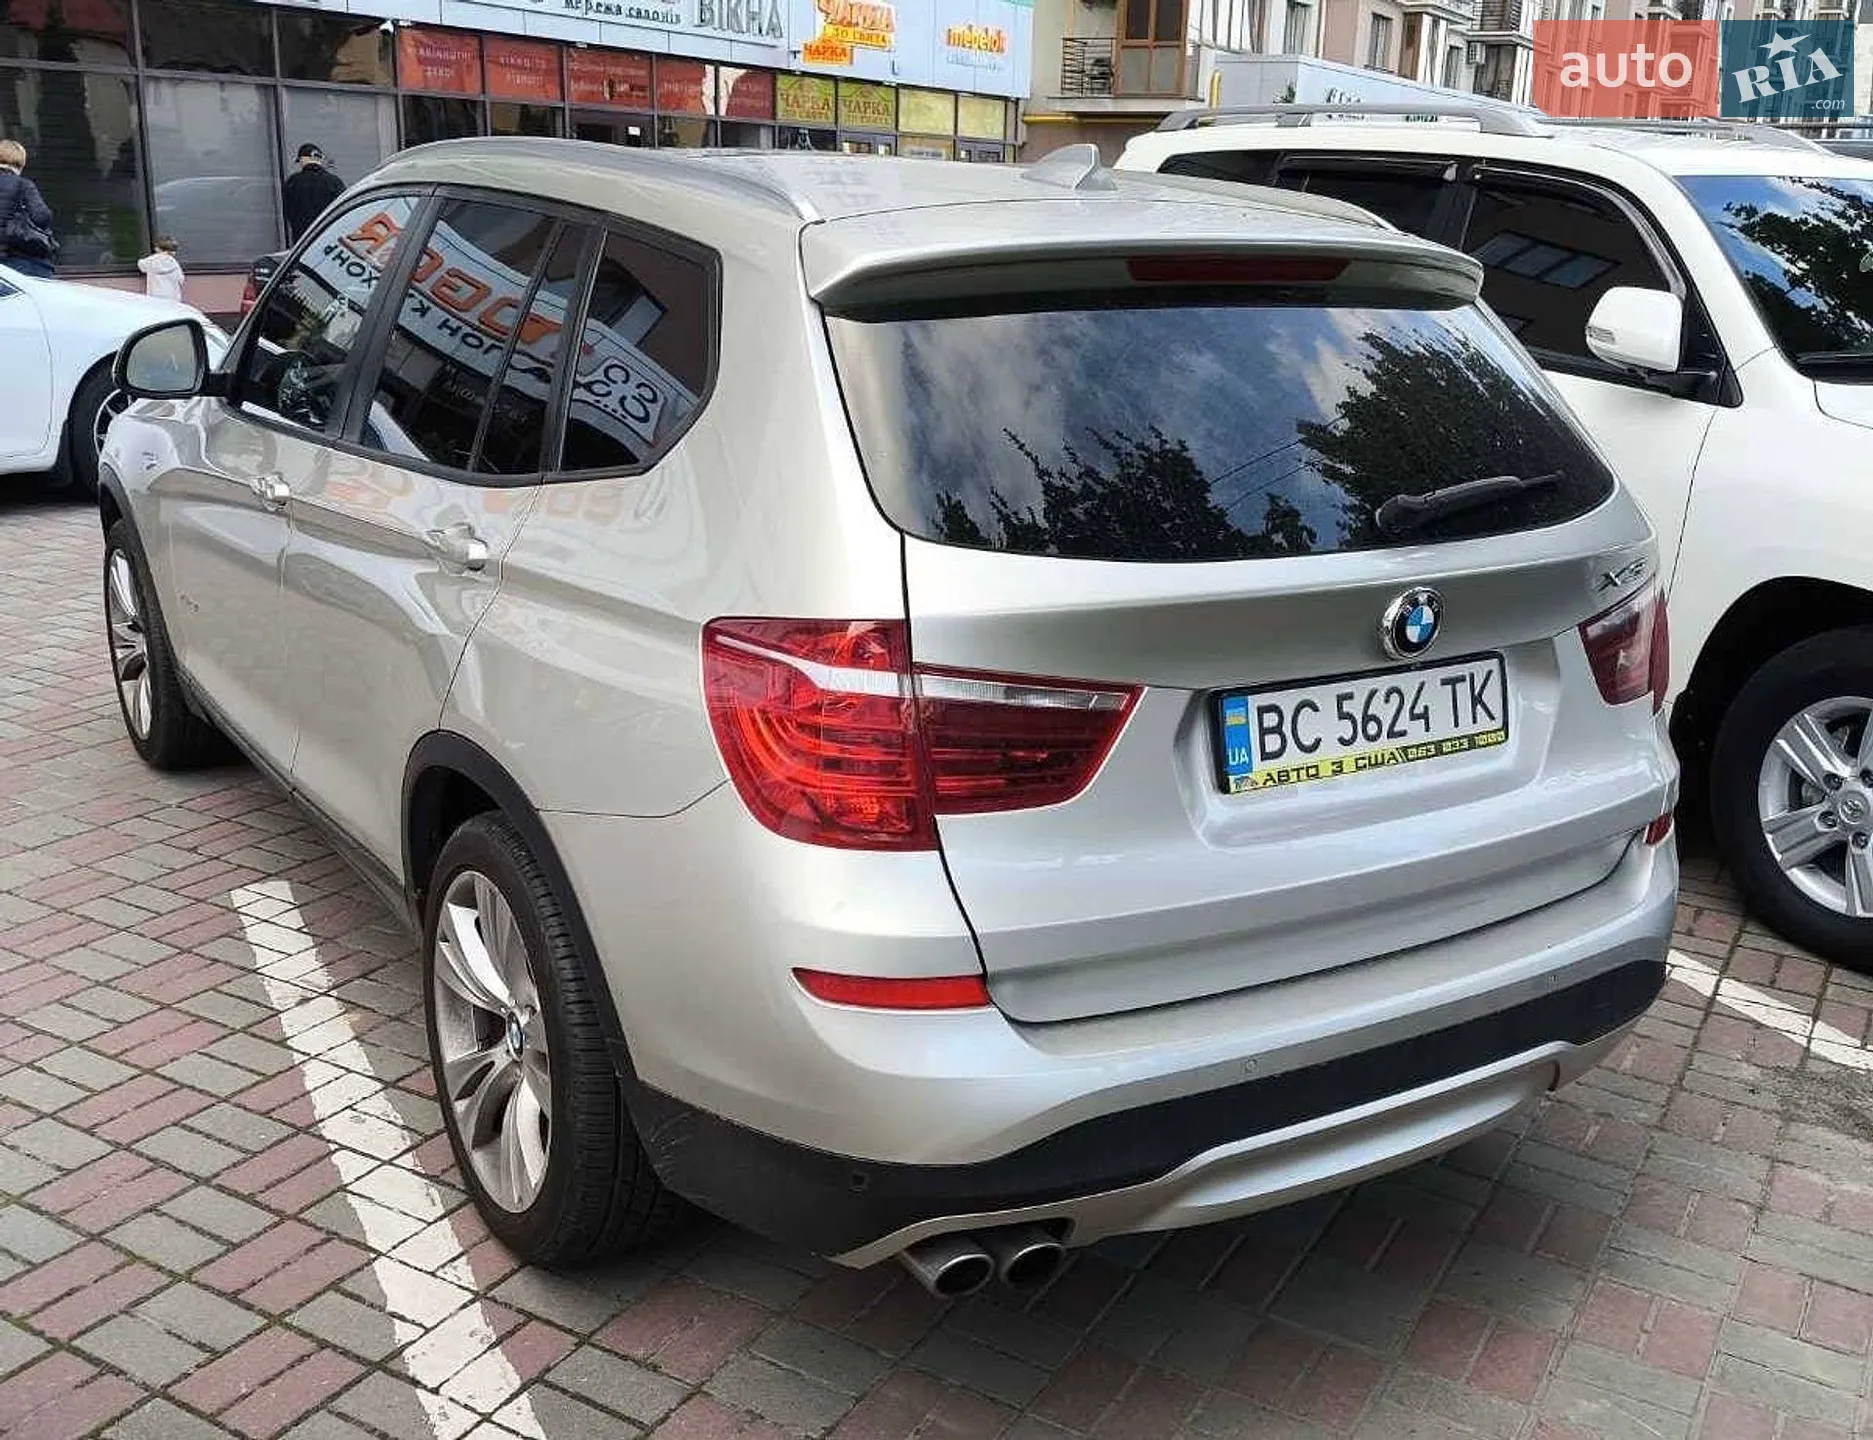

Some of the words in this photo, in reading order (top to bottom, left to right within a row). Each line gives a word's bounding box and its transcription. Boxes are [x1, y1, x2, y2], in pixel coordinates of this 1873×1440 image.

[694, 0, 783, 39] ВІКНА
[1257, 699, 1322, 761] BC
[1336, 681, 1431, 748] 5624
[1440, 669, 1496, 728] TK
[1229, 747, 1249, 766] UA
[1262, 765, 1320, 786] АВТО
[1355, 751, 1399, 771] США
